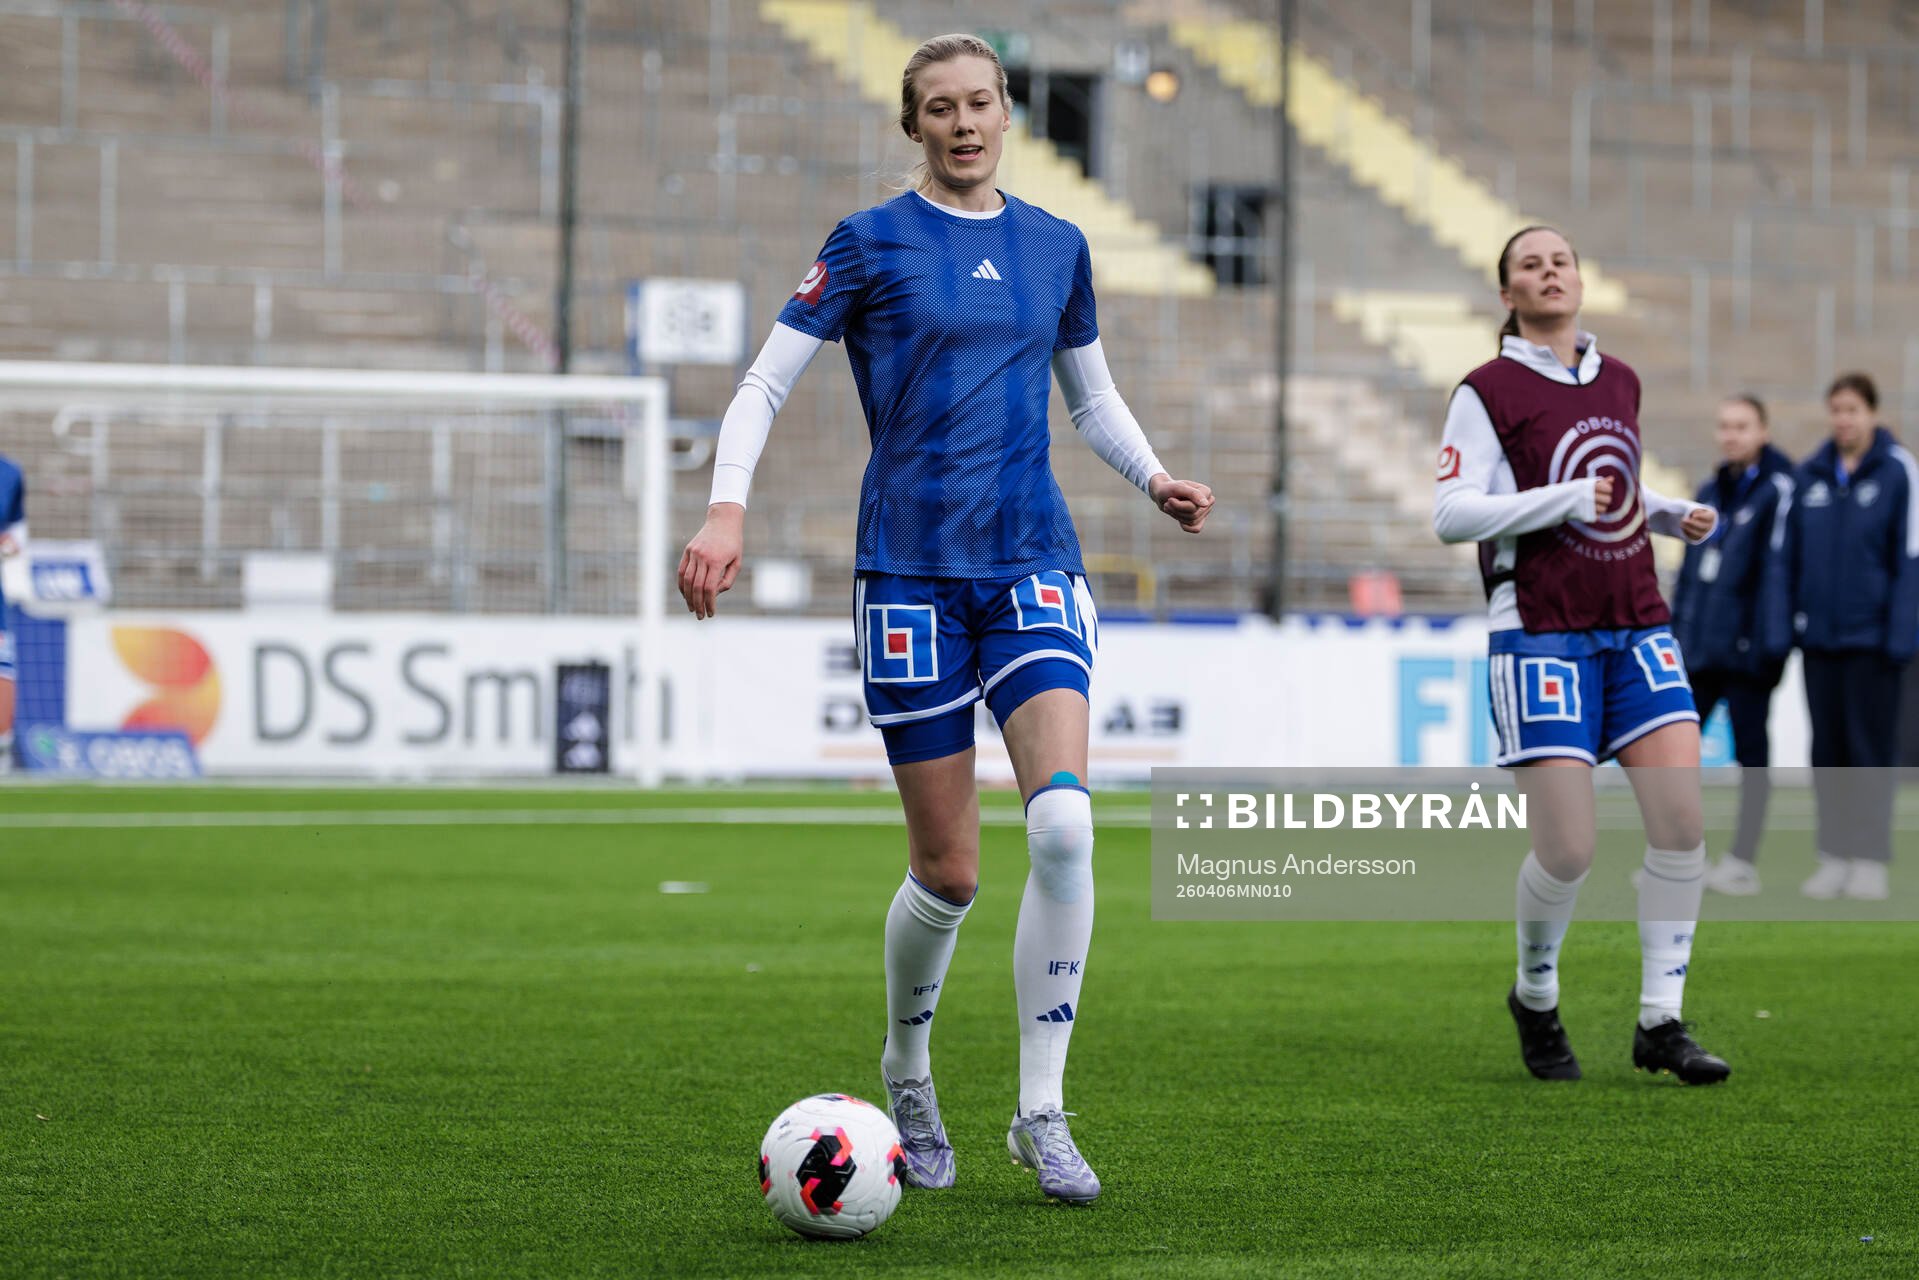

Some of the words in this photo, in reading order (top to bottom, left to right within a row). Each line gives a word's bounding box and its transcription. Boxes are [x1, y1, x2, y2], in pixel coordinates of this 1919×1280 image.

[254, 642, 375, 744] DS
[402, 641, 671, 744] Smh
[1048, 960, 1081, 976] IFK
[912, 978, 941, 996] IFK
